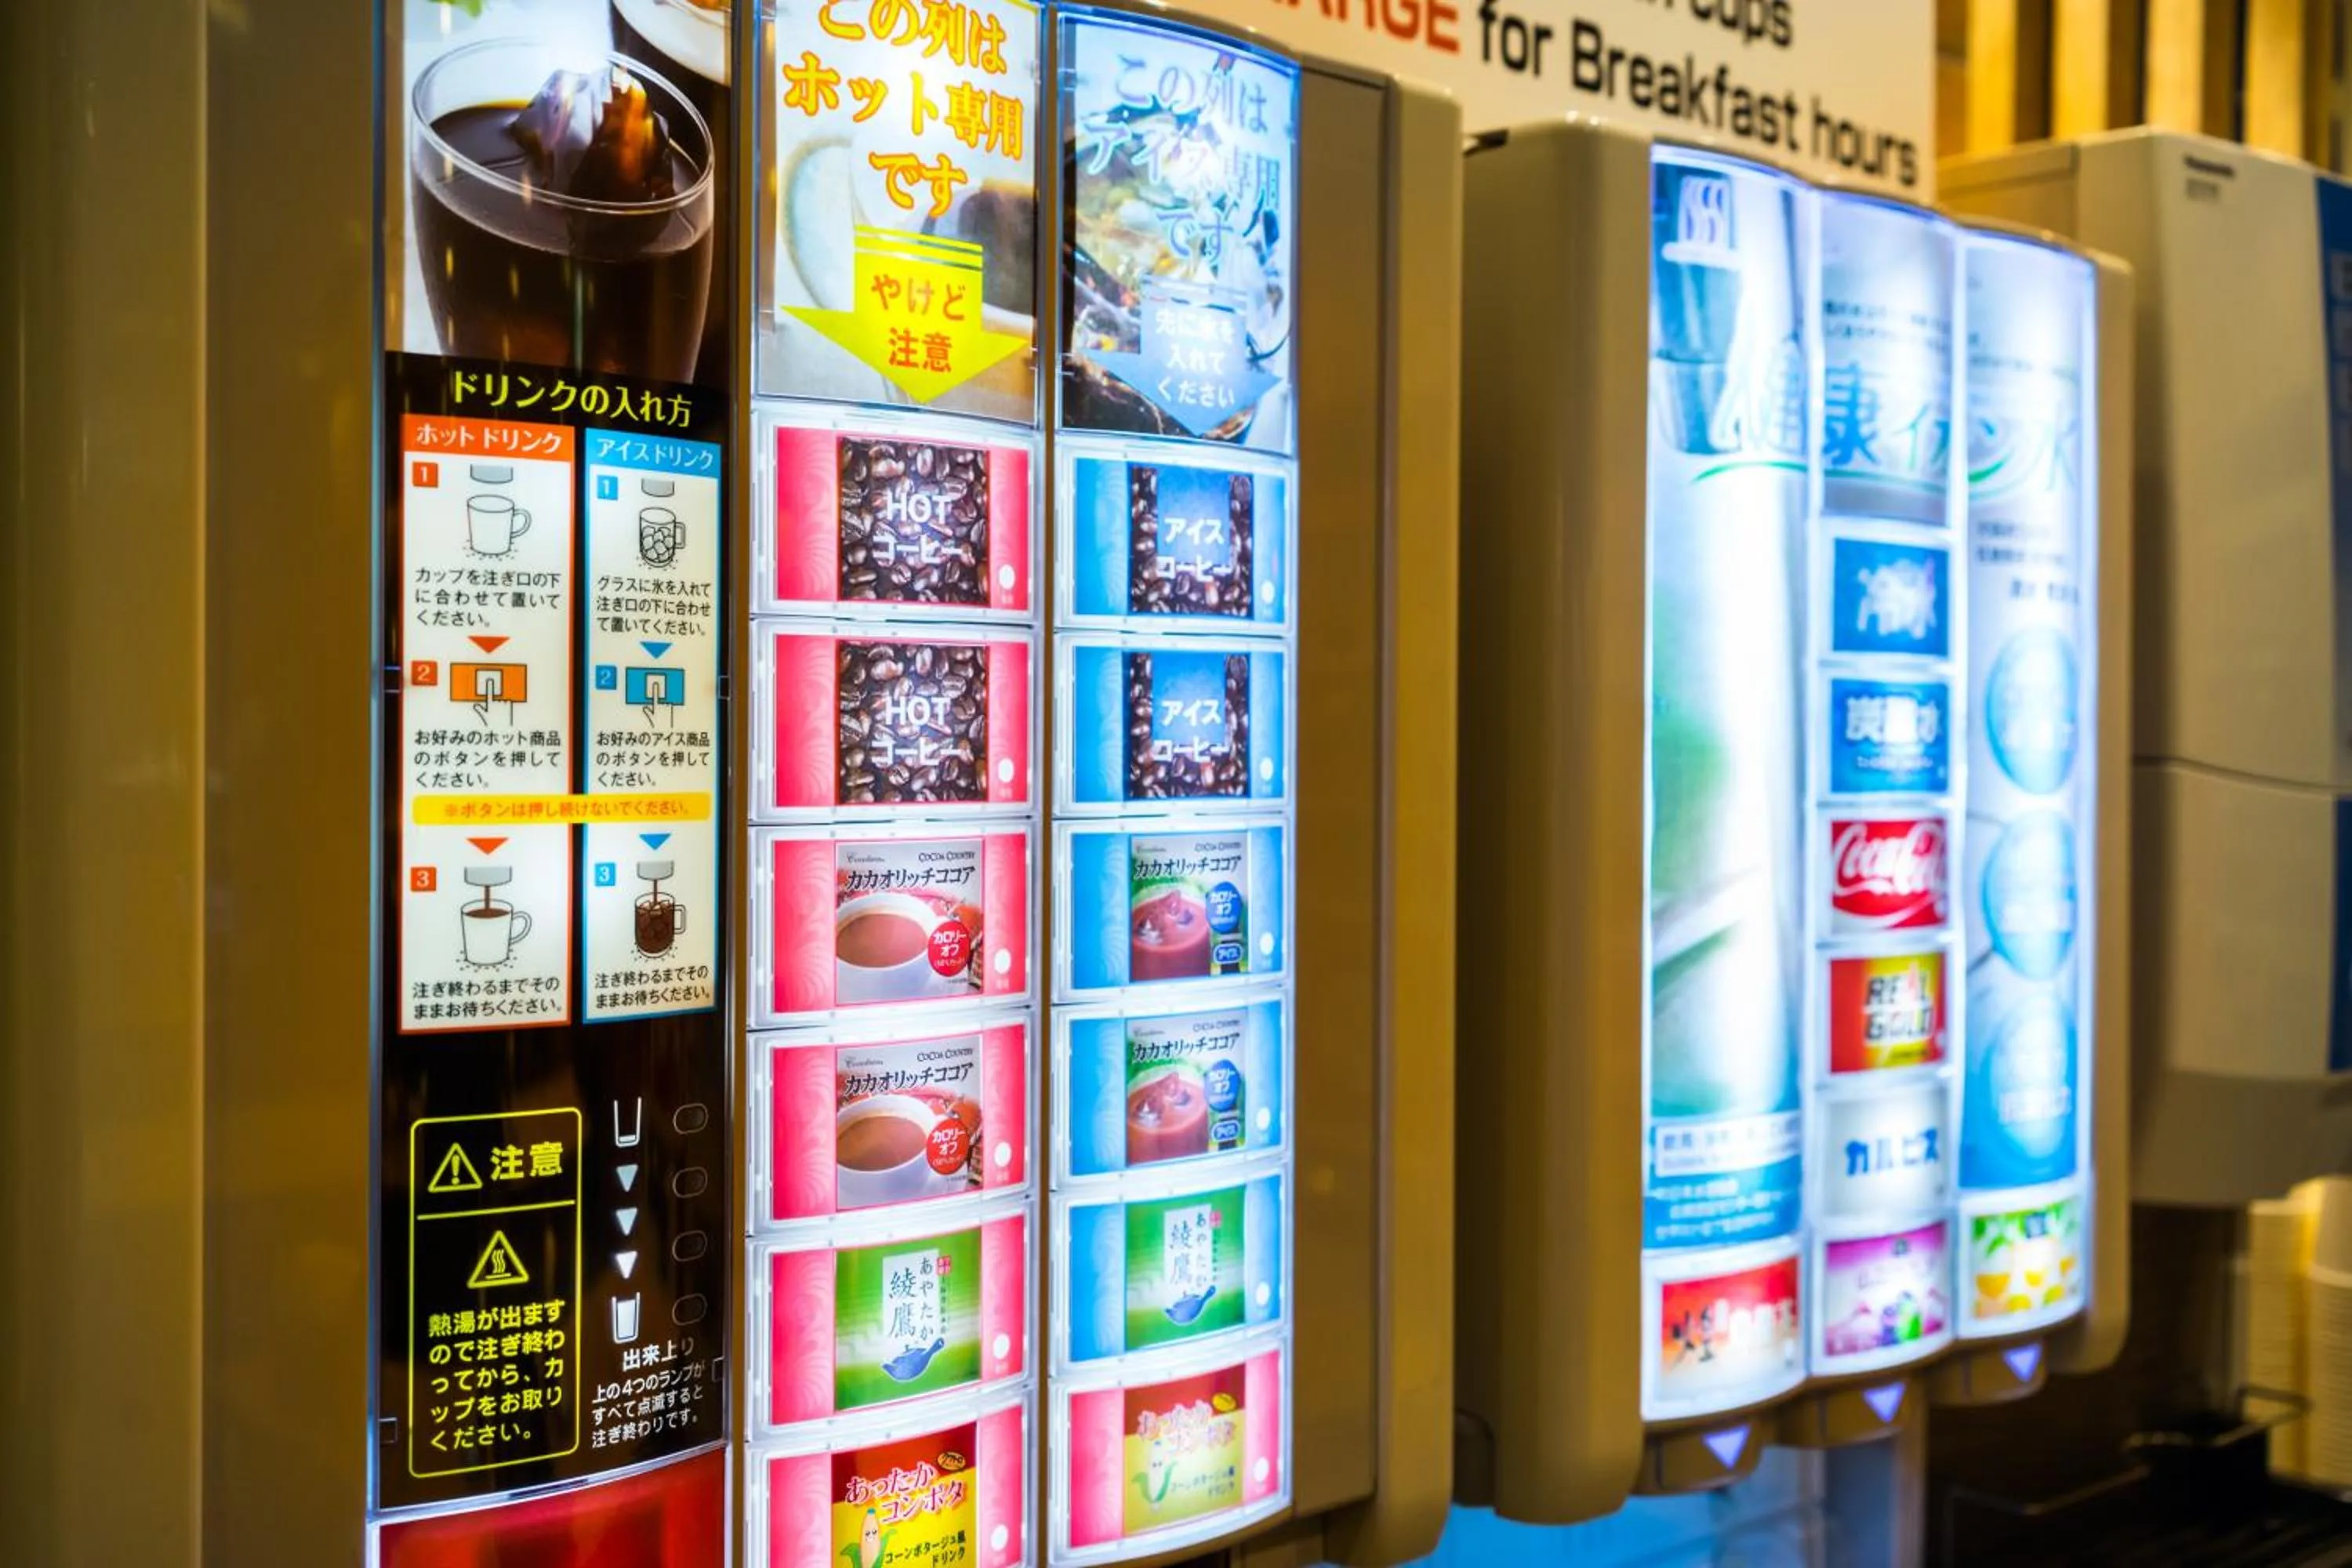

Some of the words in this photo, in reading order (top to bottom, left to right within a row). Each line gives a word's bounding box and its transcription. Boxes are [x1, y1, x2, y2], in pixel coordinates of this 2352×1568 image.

[818, 0, 1007, 74] この列は
[782, 50, 1023, 162] ホット専用
[1477, 0, 1553, 77] for
[1571, 18, 1799, 152] Breakfast
[1809, 97, 1918, 187] hours
[869, 151, 967, 220] です
[1156, 209, 1234, 262] です
[871, 273, 966, 322] やけど
[888, 327, 953, 373] 注意
[1167, 344, 1225, 375] 入れて
[453, 371, 691, 428] ドリンクの入れ方
[1157, 376, 1236, 408] ください
[416, 423, 563, 454] ホットドリンク
[597, 437, 714, 469] アイスドリンク
[884, 494, 953, 524] HOT
[1164, 517, 1224, 544] アイス
[872, 535, 963, 564] コーヒー
[415, 568, 561, 589] カップを注ぎ口の下
[1156, 555, 1232, 582] コーヒー
[415, 589, 561, 609] に合わせて置いて
[596, 575, 712, 598] グラスに氷を入れて
[416, 610, 492, 628] ください。
[596, 595, 712, 617] 注ぎ口の下に合わせ
[597, 615, 707, 637] て置いてください。
[884, 696, 951, 726] HOT
[1161, 699, 1221, 725] アイス
[414, 728, 561, 746] お好みのホット商品
[596, 730, 711, 748] お好みのアイス商品
[870, 737, 962, 766] コーヒー
[1152, 736, 1230, 762] コーヒー
[414, 750, 561, 767] のボタンを押して
[596, 750, 710, 767] のボタンを押して
[415, 770, 491, 789] ください。
[597, 770, 658, 788] ください。
[847, 866, 975, 890] カカオリッチココア
[1135, 855, 1242, 878] カカオリッチココア
[935, 930, 966, 946] カロリー
[940, 943, 960, 957] オフ
[412, 976, 561, 1000] 注ぎ終わるまでその
[594, 964, 708, 989] 注ぎ終わるまでその
[413, 997, 561, 1020] ままお待ちください。
[596, 985, 710, 1009] ままお待ちください。
[1134, 1033, 1240, 1060] カカオリッチココア
[846, 1062, 973, 1094] カカオリッチココア
[932, 1127, 965, 1143] カロリー
[939, 1141, 957, 1155] オフ
[490, 1141, 564, 1181] 注意
[920, 1257, 935, 1341] あやたか
[428, 1299, 565, 1338] 熱湯が出ます
[430, 1330, 565, 1365] ので注ぎ終わ
[622, 1337, 694, 1372] 出来上り
[431, 1358, 564, 1393] ってから、カ
[593, 1360, 706, 1403] 上の4つのランプが
[431, 1386, 562, 1424] ップをお取り
[592, 1385, 703, 1425] すべて点滅すると
[430, 1422, 533, 1452] ください。
[592, 1409, 698, 1449] 注ぎ終わりです。
[845, 1461, 935, 1504] あったか
[932, 1549, 965, 1567] ドリンク
